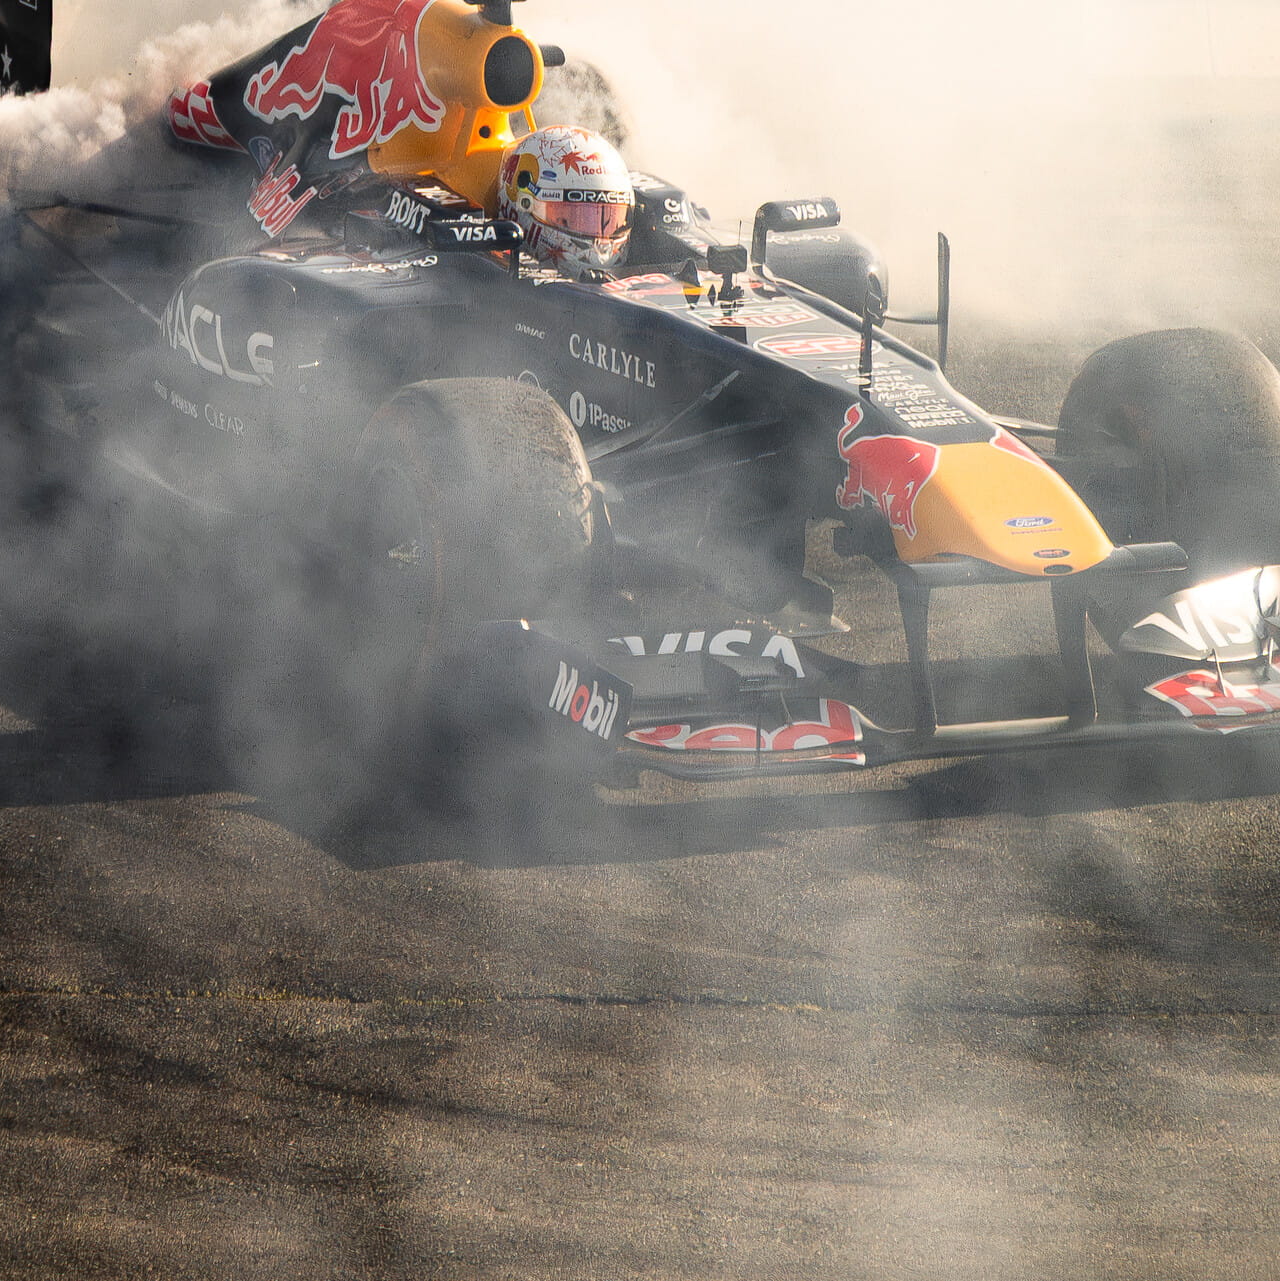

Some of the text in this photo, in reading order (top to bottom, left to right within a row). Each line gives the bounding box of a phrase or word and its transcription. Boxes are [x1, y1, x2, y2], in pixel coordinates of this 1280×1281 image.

[786, 204, 828, 220] VISA
[449, 226, 497, 242] VISA
[569, 333, 656, 388] CARLYLE
[548, 661, 619, 741] Mobil
